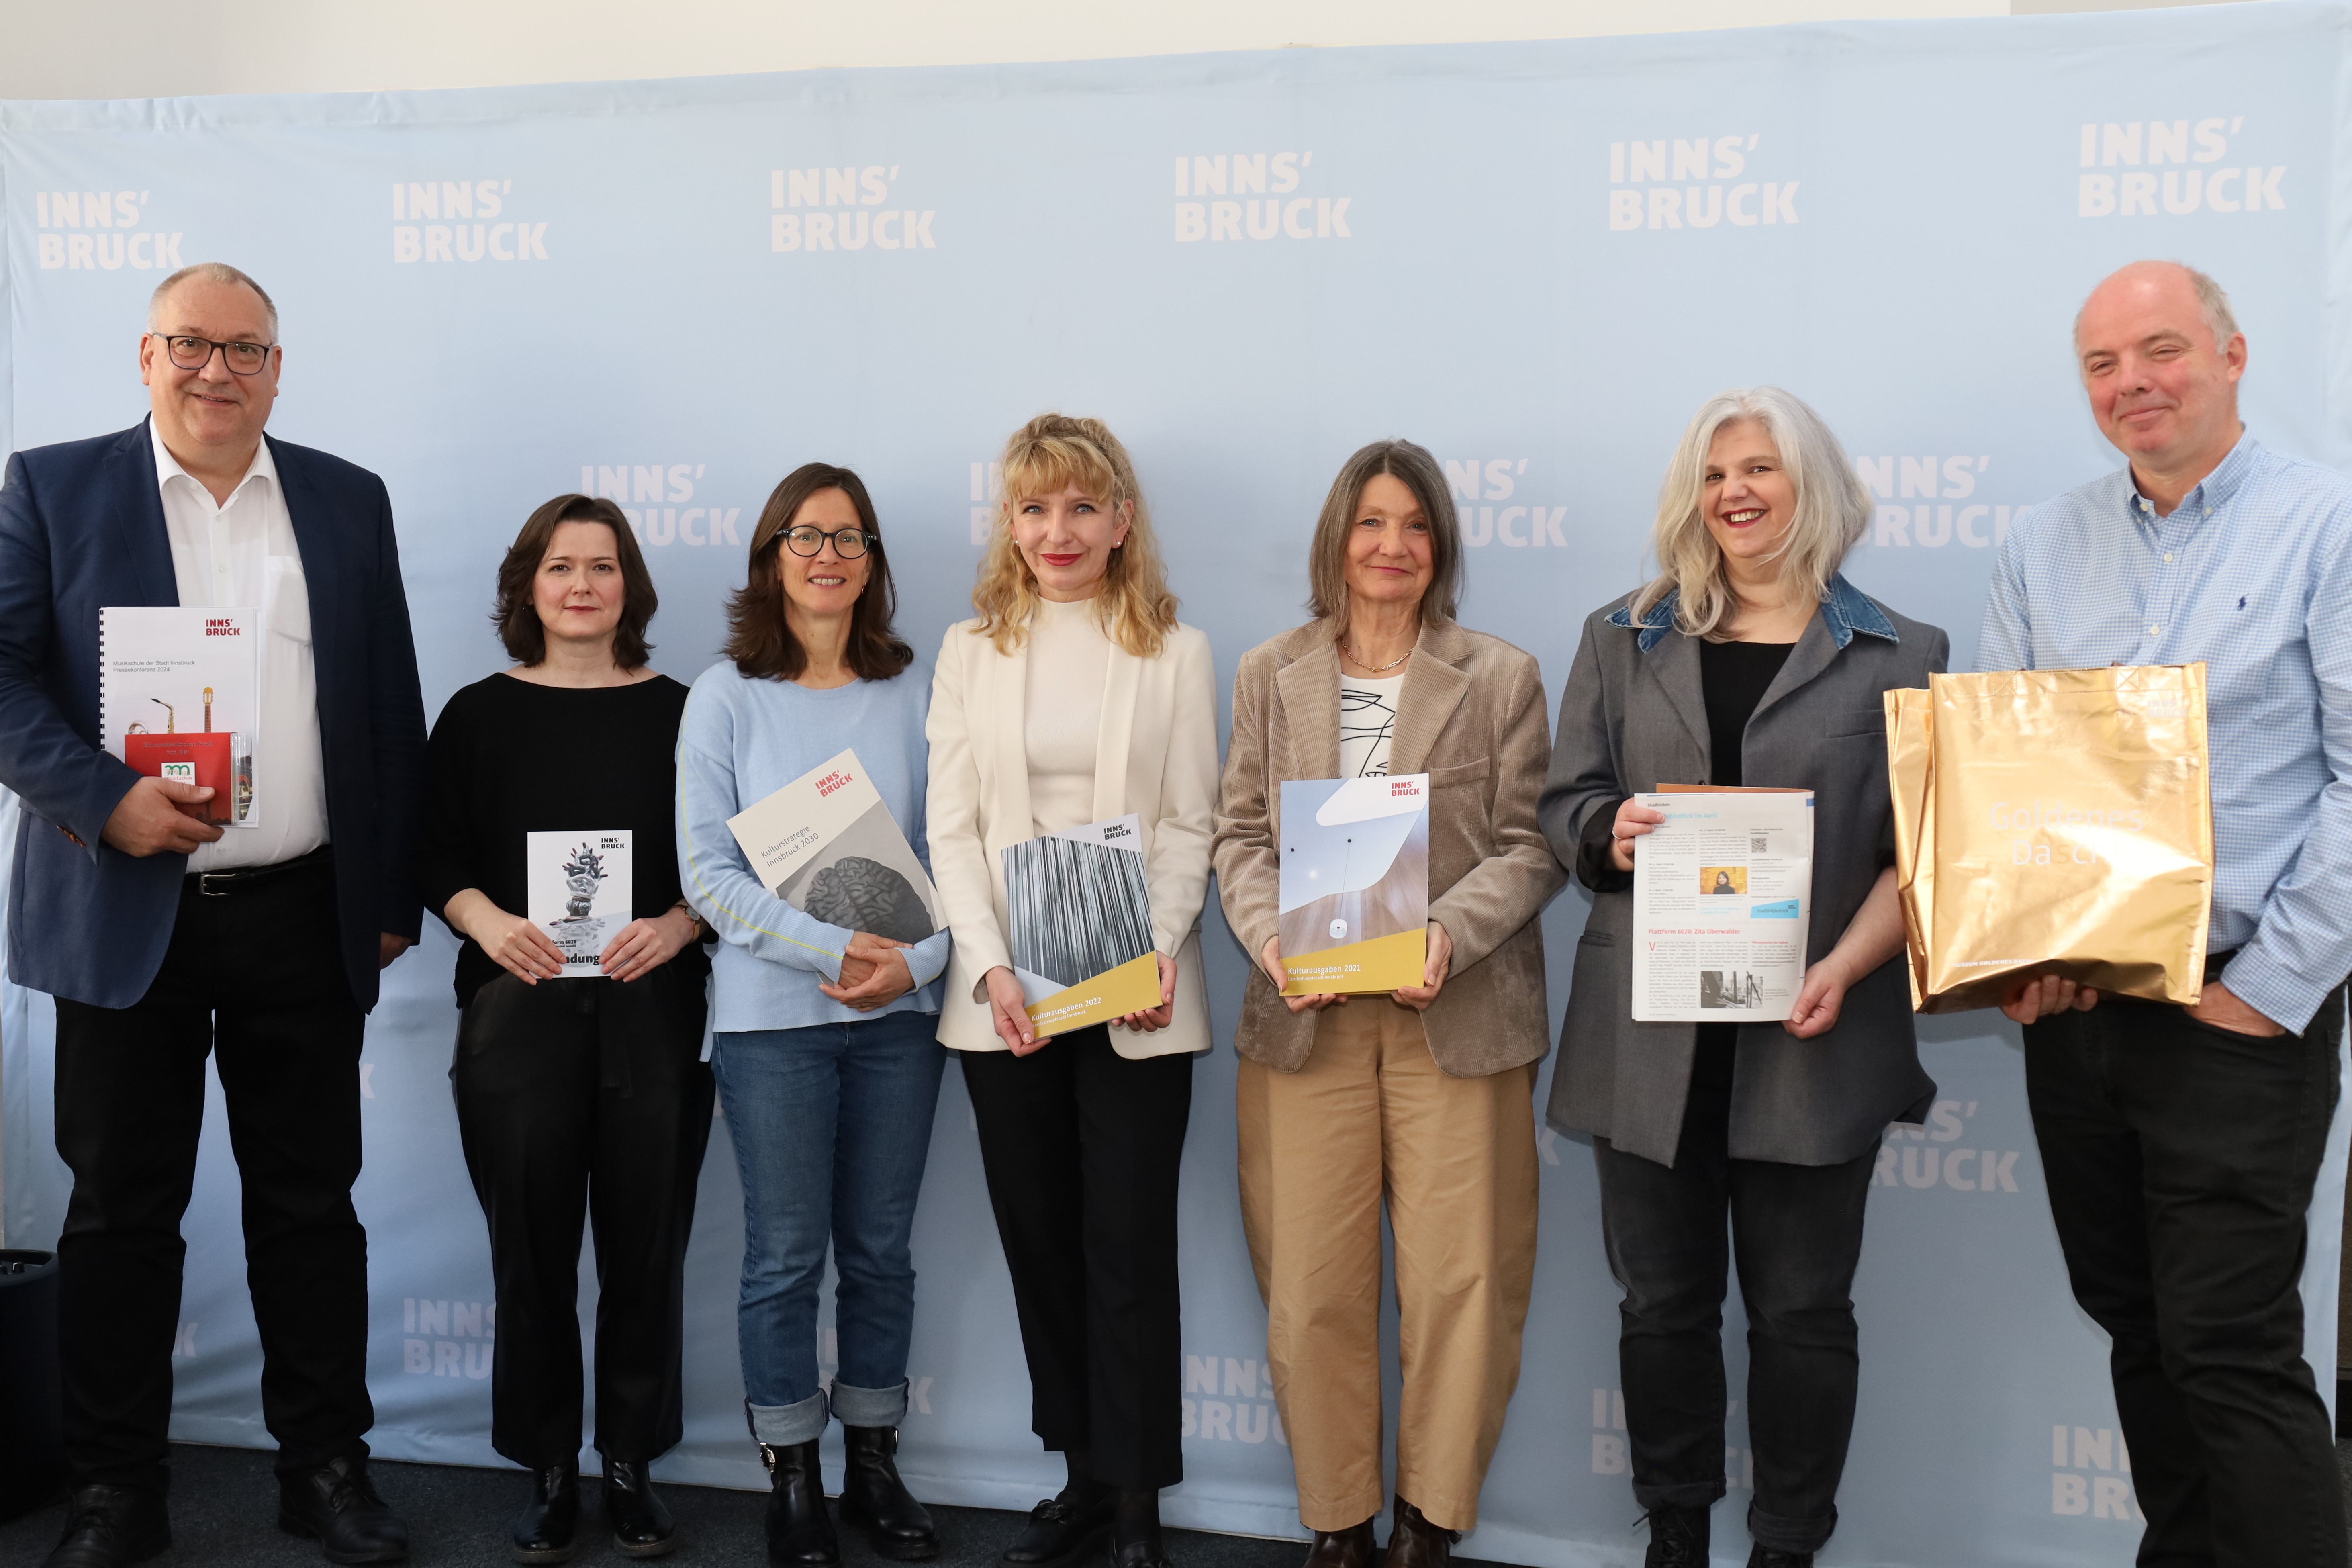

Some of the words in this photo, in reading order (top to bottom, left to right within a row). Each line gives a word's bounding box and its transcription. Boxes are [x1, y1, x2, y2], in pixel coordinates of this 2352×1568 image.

[1610, 133, 1759, 183] INNS'
[2080, 115, 2244, 167] INNS'
[771, 165, 899, 208] INNS'
[1175, 151, 1313, 196] INNS'
[2078, 166, 2287, 217] BRUCK
[37, 190, 149, 228] INNS'
[393, 179, 512, 220] INNS'
[1175, 197, 1352, 242] BRUCK
[1609, 181, 1800, 231] BRUCK
[38, 232, 184, 270] BRUCK
[393, 222, 549, 263] BRUCK
[772, 210, 936, 252] BRUCK
[582, 464, 705, 503] INNS'
[1445, 458, 1528, 500] NS'
[1849, 455, 1990, 499] NNS'
[621, 507, 741, 546] RUCK
[1459, 506, 1568, 547] UCK
[815, 769, 840, 790] INNS'
[819, 773, 854, 797] BRUCK
[1104, 824, 1124, 833] INNS'
[1105, 829, 1131, 840] BRUCK
[1990, 801, 2143, 831] Goldenes
[761, 825, 810, 858] Kulturstrategie
[766, 844, 801, 868] Innsbruck
[801, 833, 819, 847] 2030
[1288, 965, 1342, 975] Kulturausgaben
[1031, 1002, 1083, 1021] Kulturausgaben
[1085, 996, 1102, 1007] 2022
[1033, 1015, 1067, 1027] Landeshauptstadt
[1870, 1146, 2020, 1192] RUCK
[404, 1338, 493, 1380] BRU
